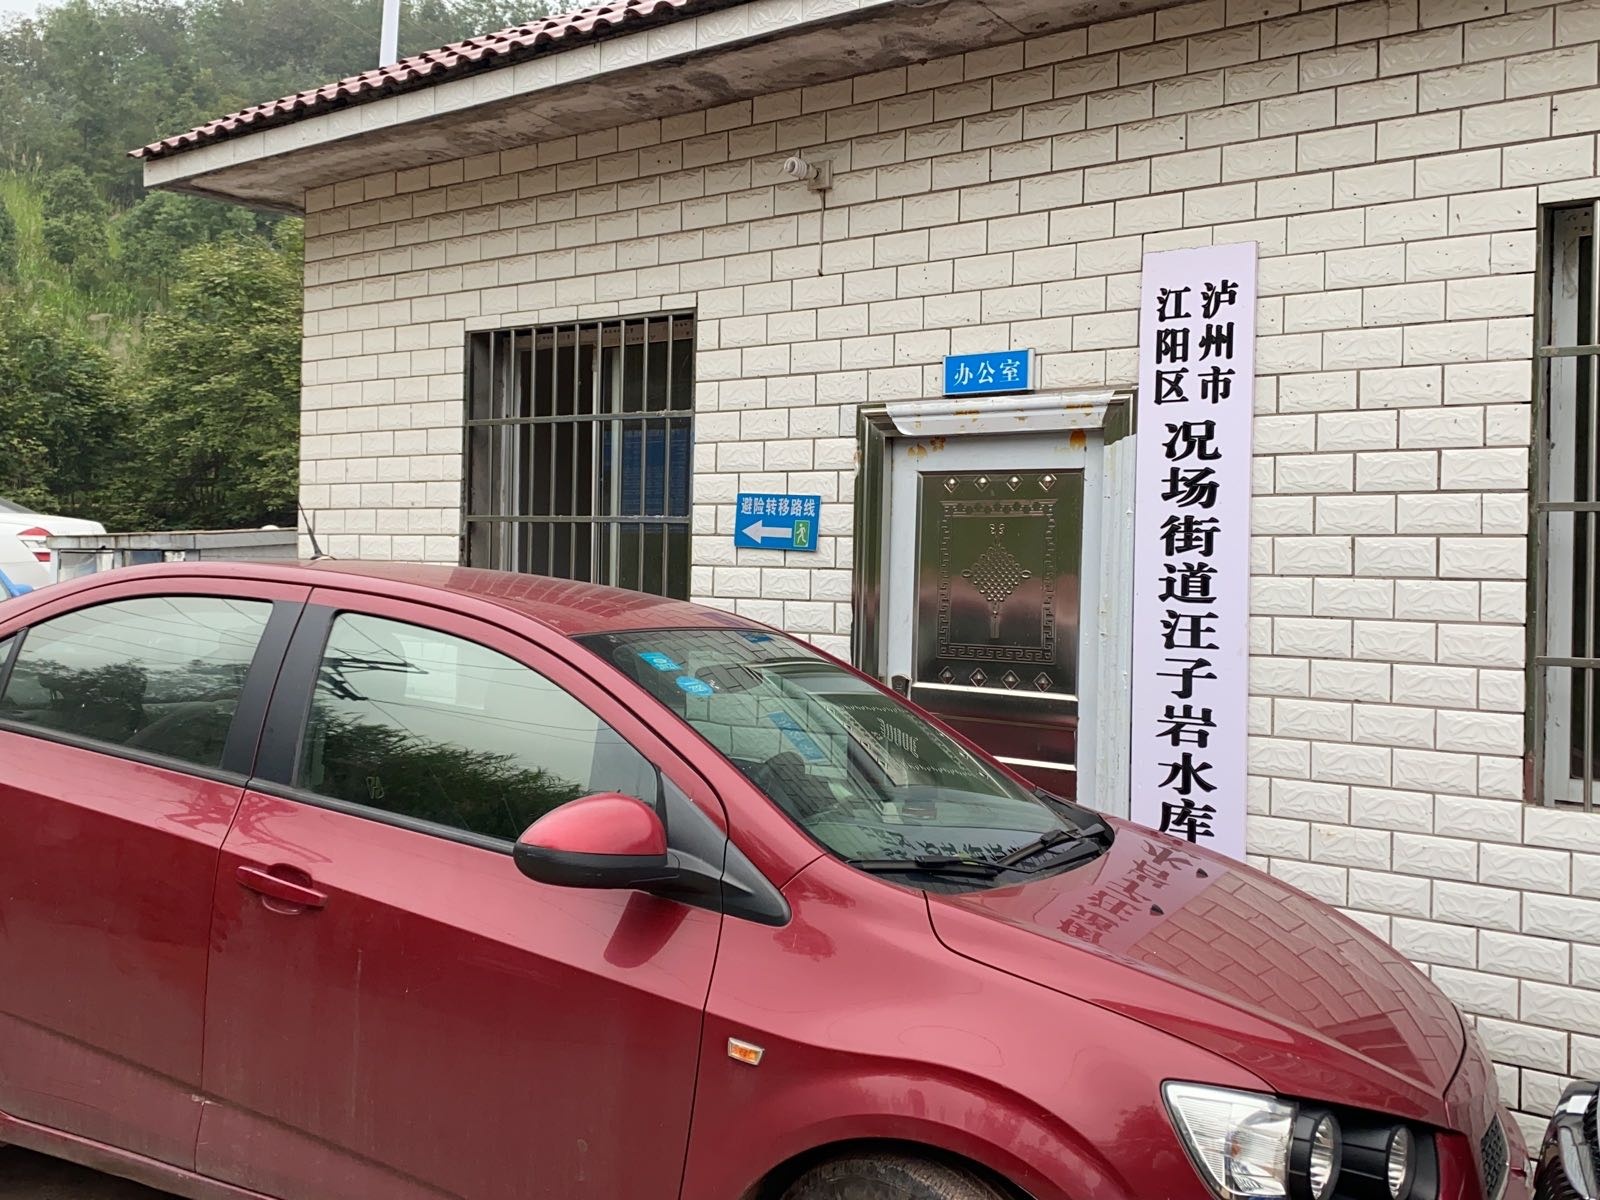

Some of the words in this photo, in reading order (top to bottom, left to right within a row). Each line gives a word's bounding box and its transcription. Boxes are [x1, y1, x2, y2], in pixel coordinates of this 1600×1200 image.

[953, 358, 1021, 386] 办公室
[1153, 286, 1192, 406] 江阳区
[1197, 279, 1239, 405] 泸州市
[740, 496, 816, 518] 避险转移路线
[1155, 419, 1223, 844] 况场街道汪子岩水库
